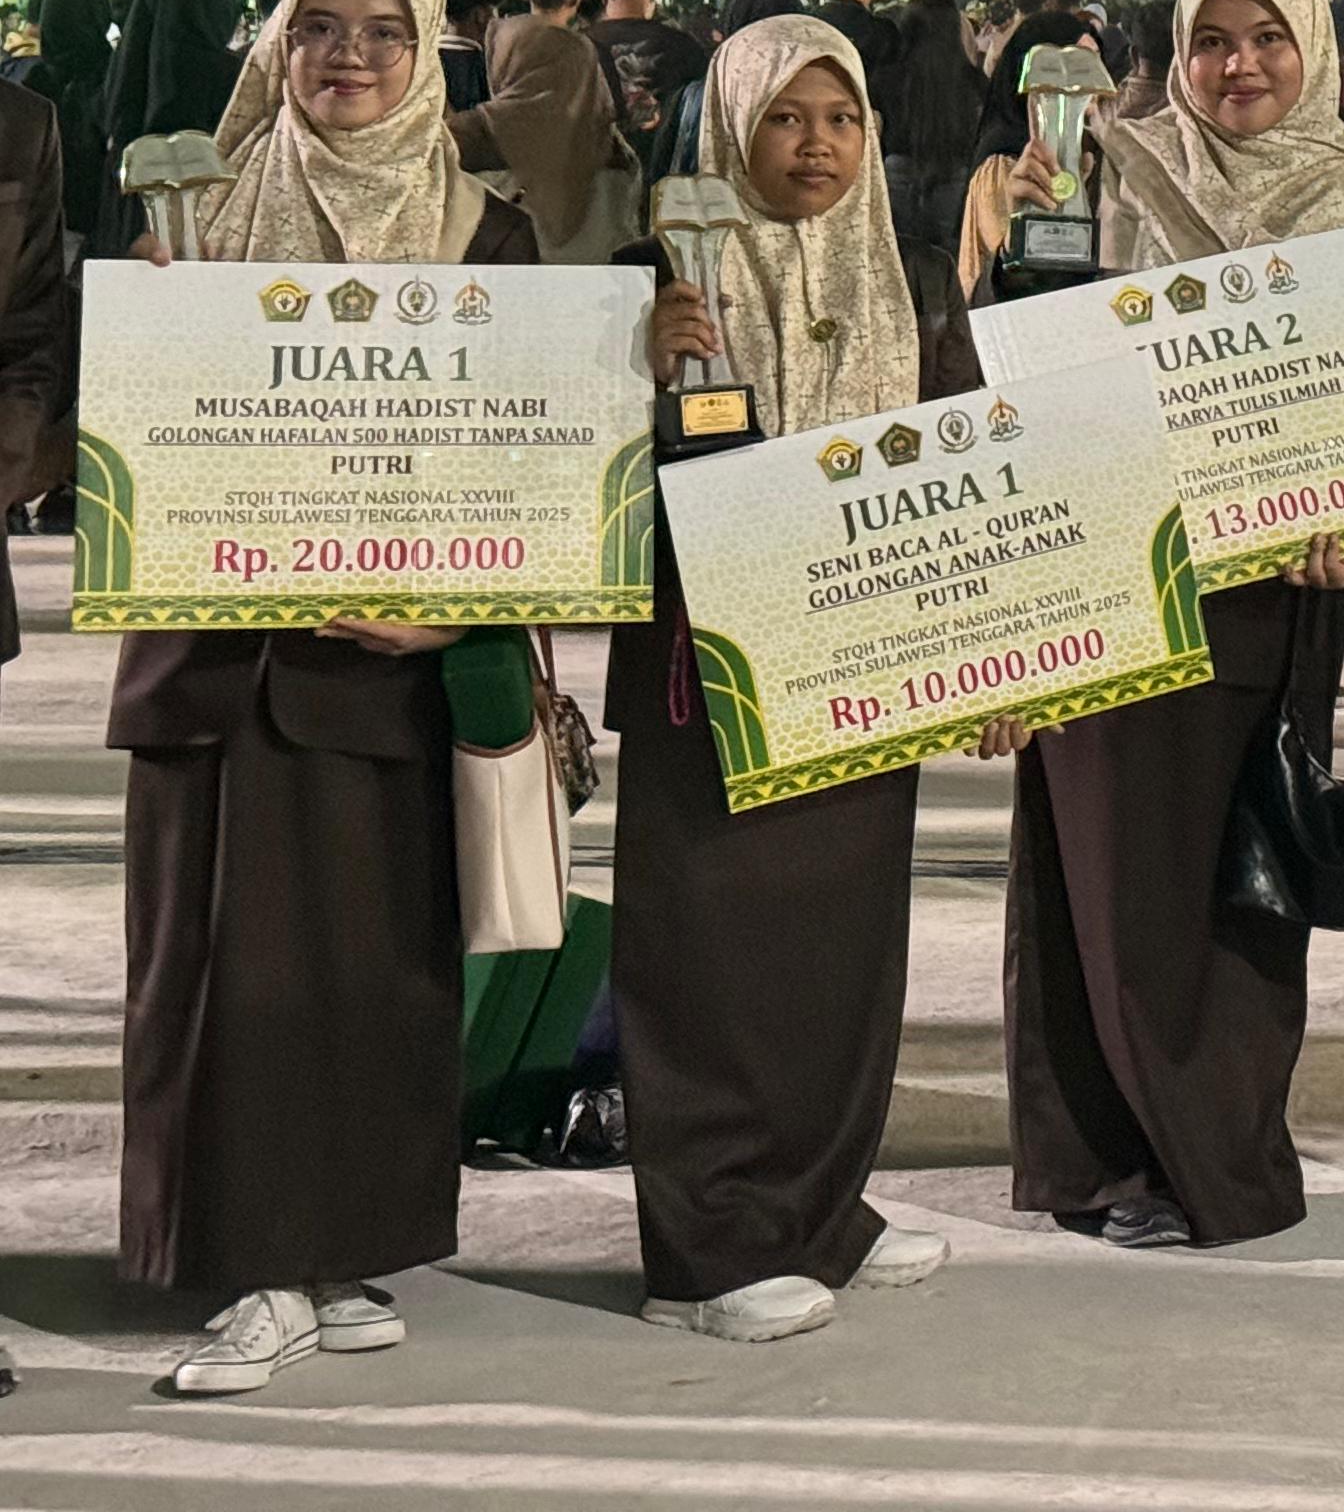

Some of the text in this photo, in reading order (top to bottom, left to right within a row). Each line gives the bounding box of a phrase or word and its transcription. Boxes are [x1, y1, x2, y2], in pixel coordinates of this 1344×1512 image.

[1135, 312, 1303, 372] UARA 2
[267, 345, 472, 390] JUARA 1
[1231, 356, 1311, 390] HADIST
[194, 397, 547, 422] MUSABAQAH HADIST NABI
[1165, 404, 1227, 430] KARYA
[1225, 391, 1280, 417] TULIS
[1278, 377, 1343, 406] ILMIAH
[145, 426, 594, 445] GOLONGAN HAFALAN 500 HADIST TANPA SANAD
[1211, 416, 1280, 447] PUTRI
[331, 454, 412, 474] PUTRI
[1177, 474, 1245, 501] ULAWESI
[1245, 456, 1325, 485] TENGGARA
[1180, 456, 1245, 483] TINGKAT
[1248, 440, 1321, 468] NASIONAL
[166, 506, 570, 525] PROVINSI SULAWESI TENGGARA TAHUN 2025
[223, 488, 515, 509] STQH TINGKAT NASIONAL XXVIII
[839, 461, 1024, 546] JUARA 1
[212, 536, 524, 583] Rp. 20.000.000
[806, 552, 862, 583] SENI
[866, 535, 932, 567] BACA
[937, 527, 968, 550] AL
[985, 498, 1070, 539] QUR'AN
[808, 521, 1086, 609] GOLONGAN ANAK-ANAK
[915, 575, 989, 611] PUTRI
[784, 589, 1131, 695] PROVINSI SULAWESI TENGGARA TAHUN 2025
[831, 586, 1081, 664] STQH TINGKAT NASIONAL XXVIII
[828, 628, 1104, 732] Rp. 10.000.000
